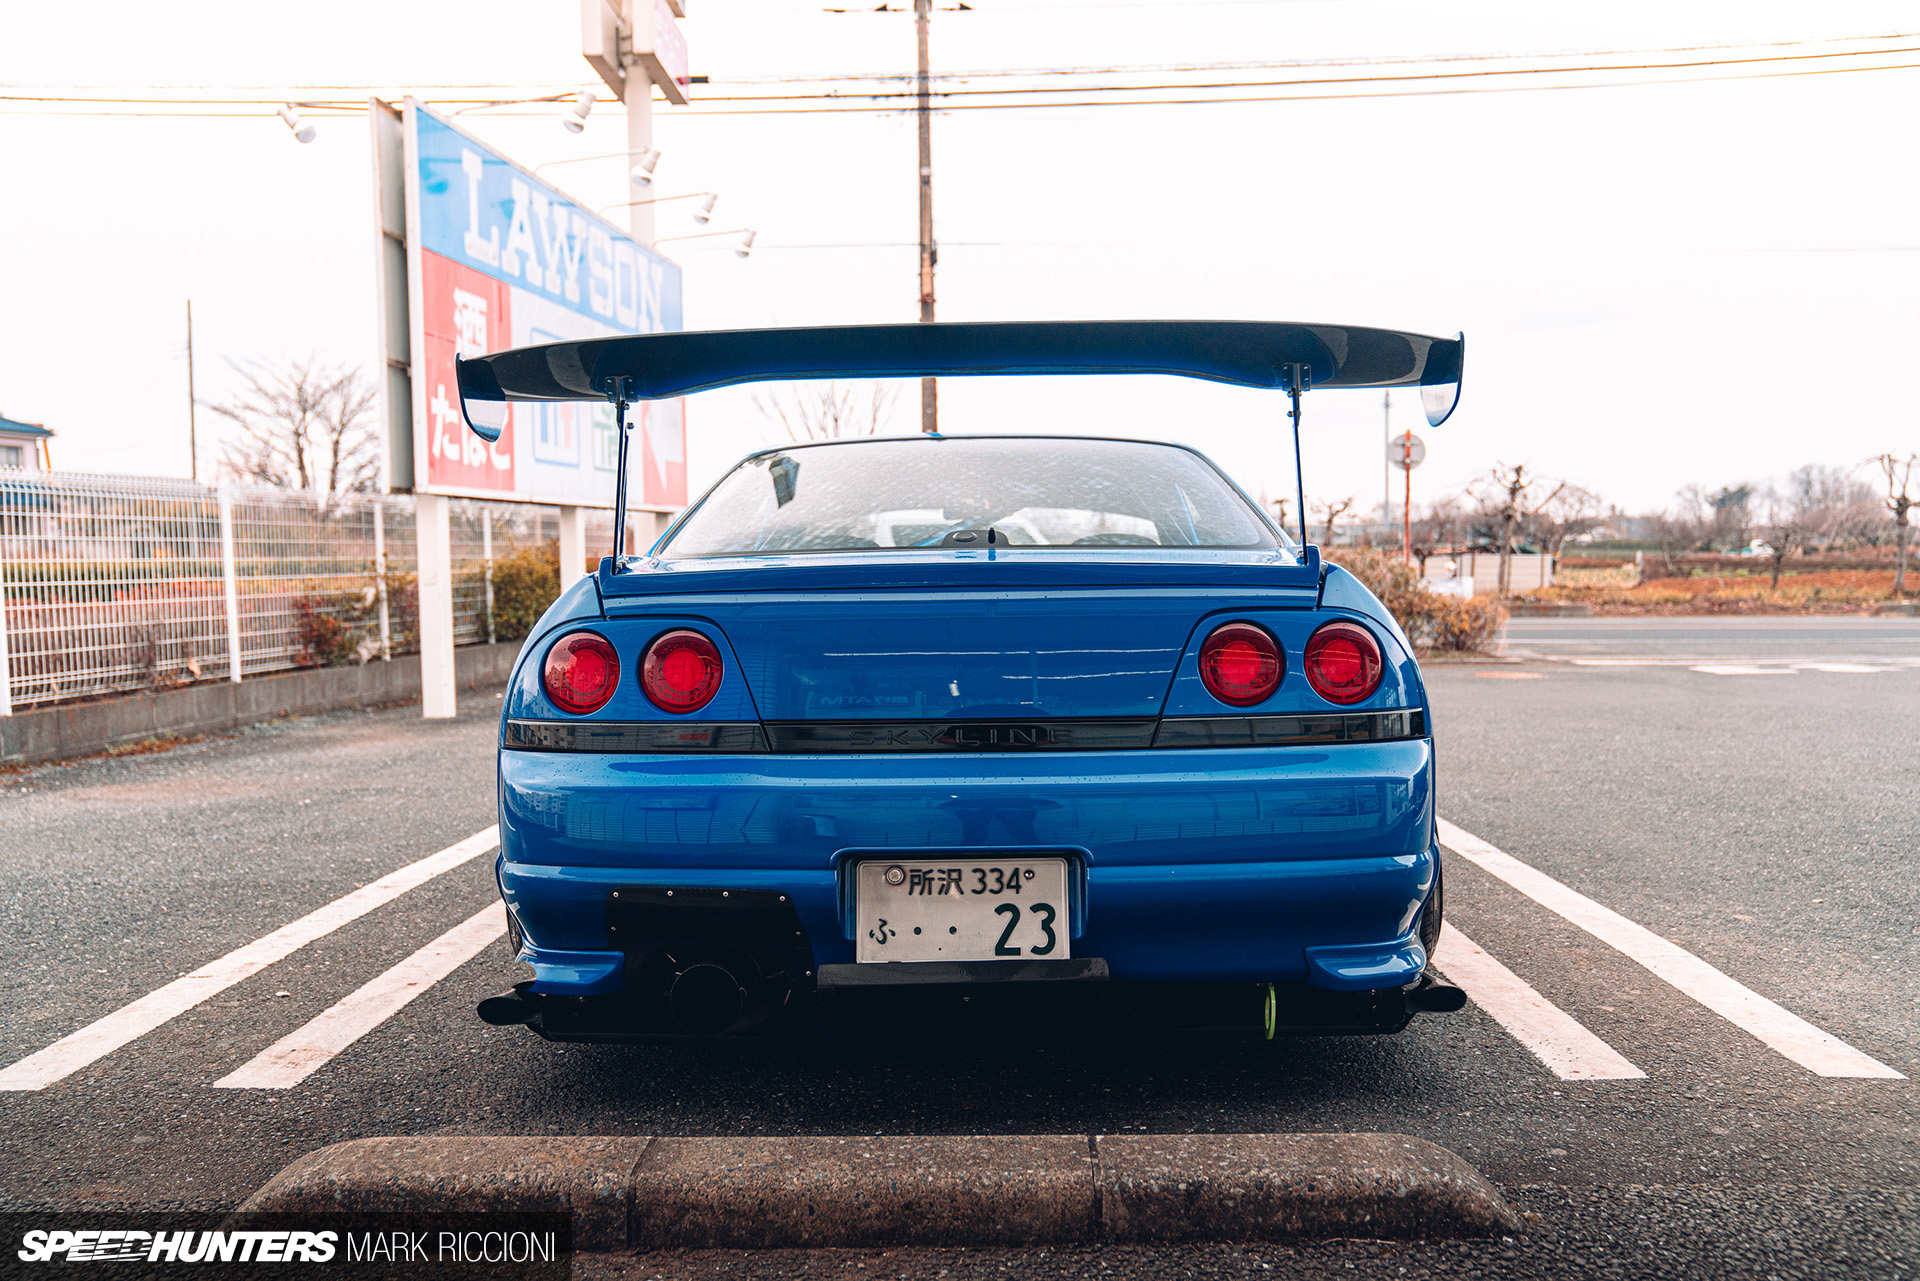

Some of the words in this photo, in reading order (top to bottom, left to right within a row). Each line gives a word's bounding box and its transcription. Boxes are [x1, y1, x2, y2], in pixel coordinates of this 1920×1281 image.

[461, 147, 665, 334] LAWSON
[453, 286, 487, 359] 酒
[848, 727, 1074, 746] SKYLINE
[909, 868, 964, 896] 所沢
[971, 867, 1021, 895] 334
[869, 918, 896, 945] ふ
